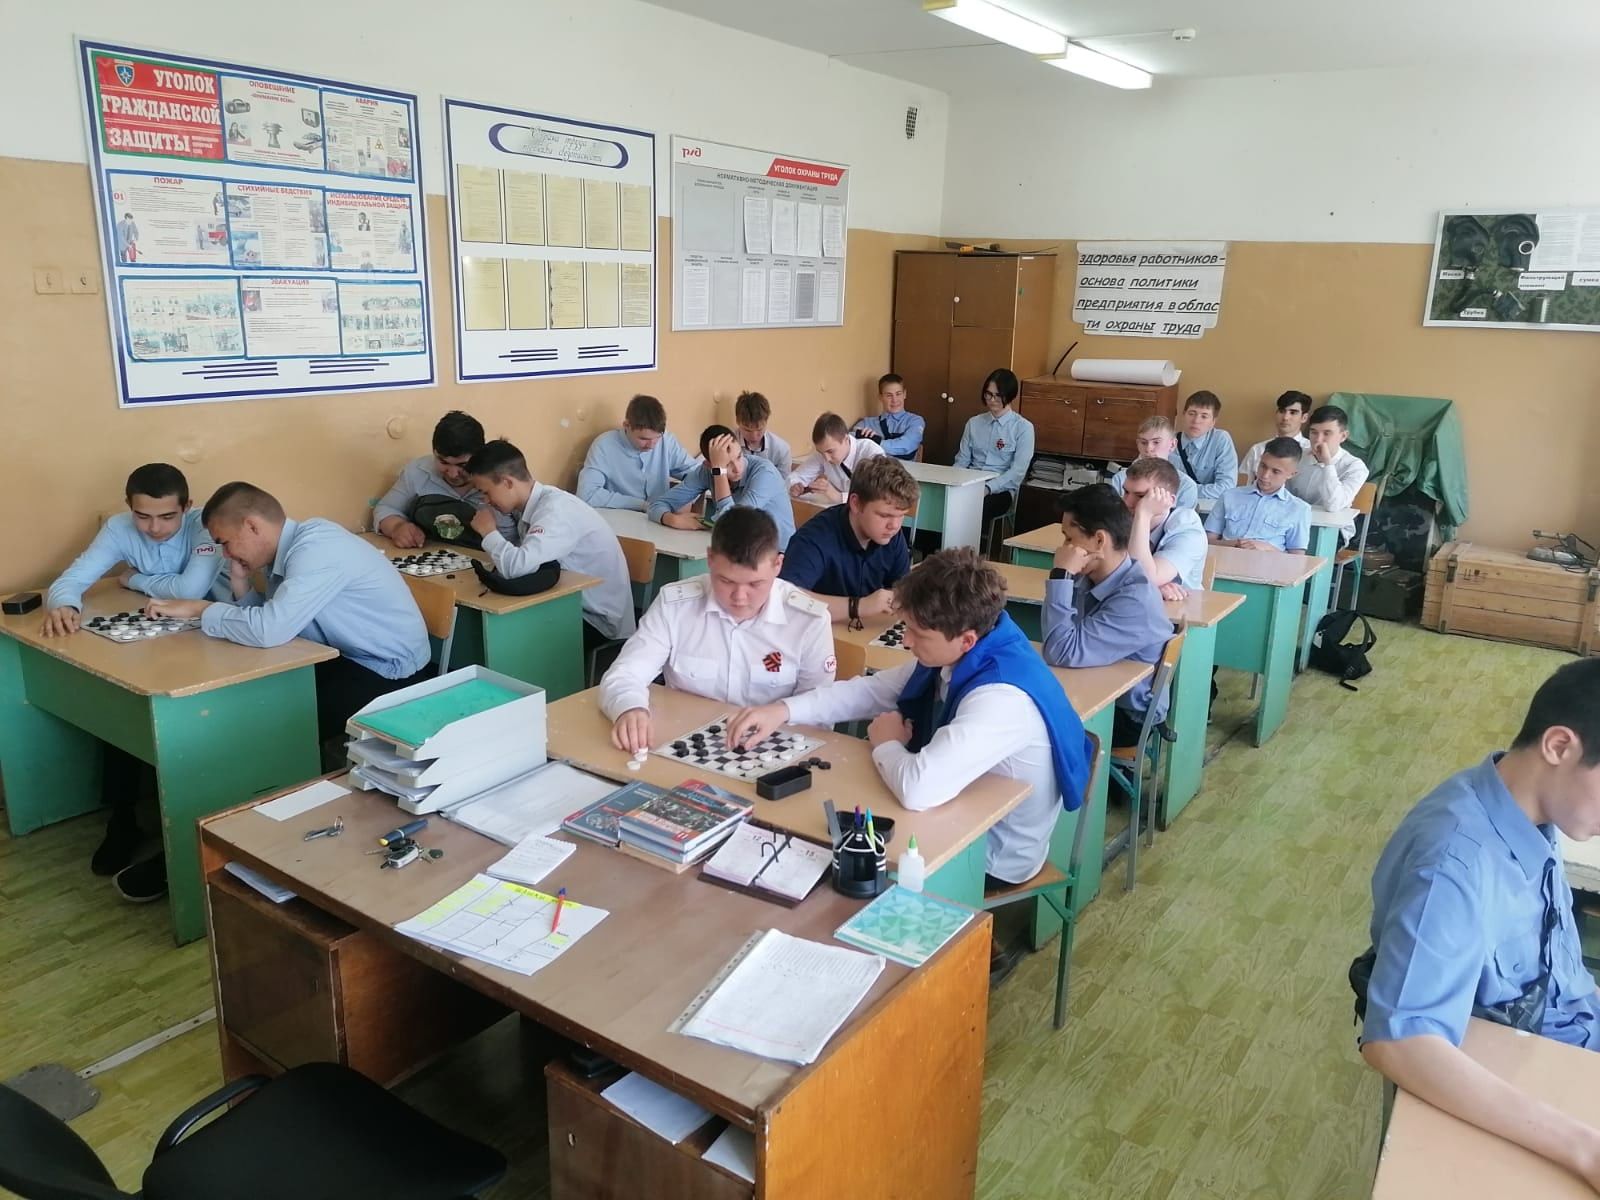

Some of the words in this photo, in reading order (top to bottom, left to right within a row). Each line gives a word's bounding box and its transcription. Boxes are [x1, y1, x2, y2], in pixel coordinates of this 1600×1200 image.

[153, 69, 216, 95] УГОЛОК
[100, 94, 222, 126] ГРАЖДАНСКОЙ
[109, 127, 192, 153] ЗАЩИТЫ
[773, 164, 797, 175] УГОЛОК
[797, 168, 820, 178] ОХРАНЫ
[820, 171, 838, 181] ТРУДА
[153, 177, 184, 186] ПОЖАР
[114, 192, 125, 201] 01
[1079, 253, 1137, 267] здоровья
[1080, 276, 1126, 287] основа
[1129, 277, 1200, 289] политики
[1076, 298, 1163, 312] предприятия
[1086, 319, 1101, 329] ти
[1105, 321, 1156, 333] охраны
[1162, 322, 1201, 335] труда
